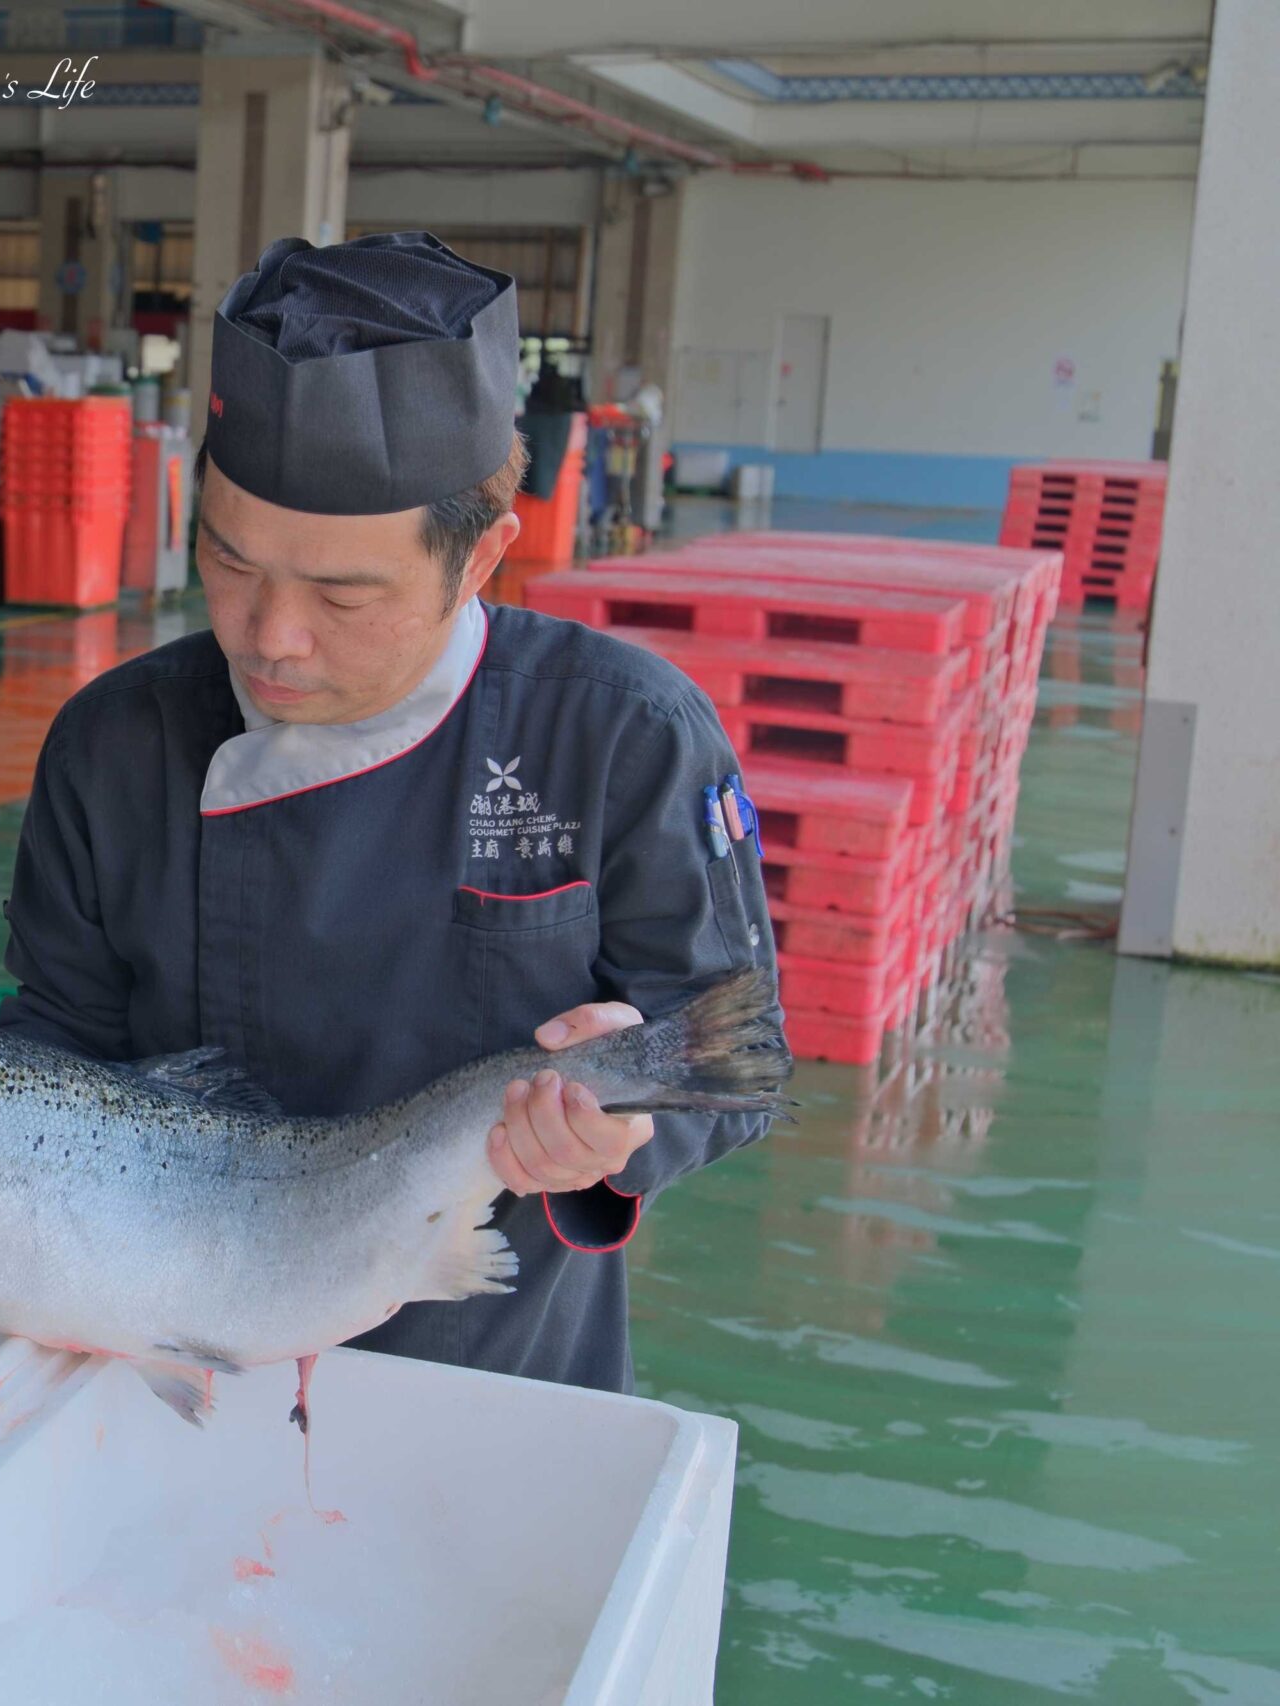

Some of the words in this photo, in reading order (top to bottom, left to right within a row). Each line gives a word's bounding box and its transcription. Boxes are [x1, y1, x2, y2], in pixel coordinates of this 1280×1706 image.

[470, 792, 541, 816] 潮港城
[469, 819, 496, 828] CHAO
[498, 817, 523, 828] KANG
[526, 813, 556, 824] CHENG
[469, 827, 514, 837] GOURMET
[517, 824, 552, 835] CUISINE
